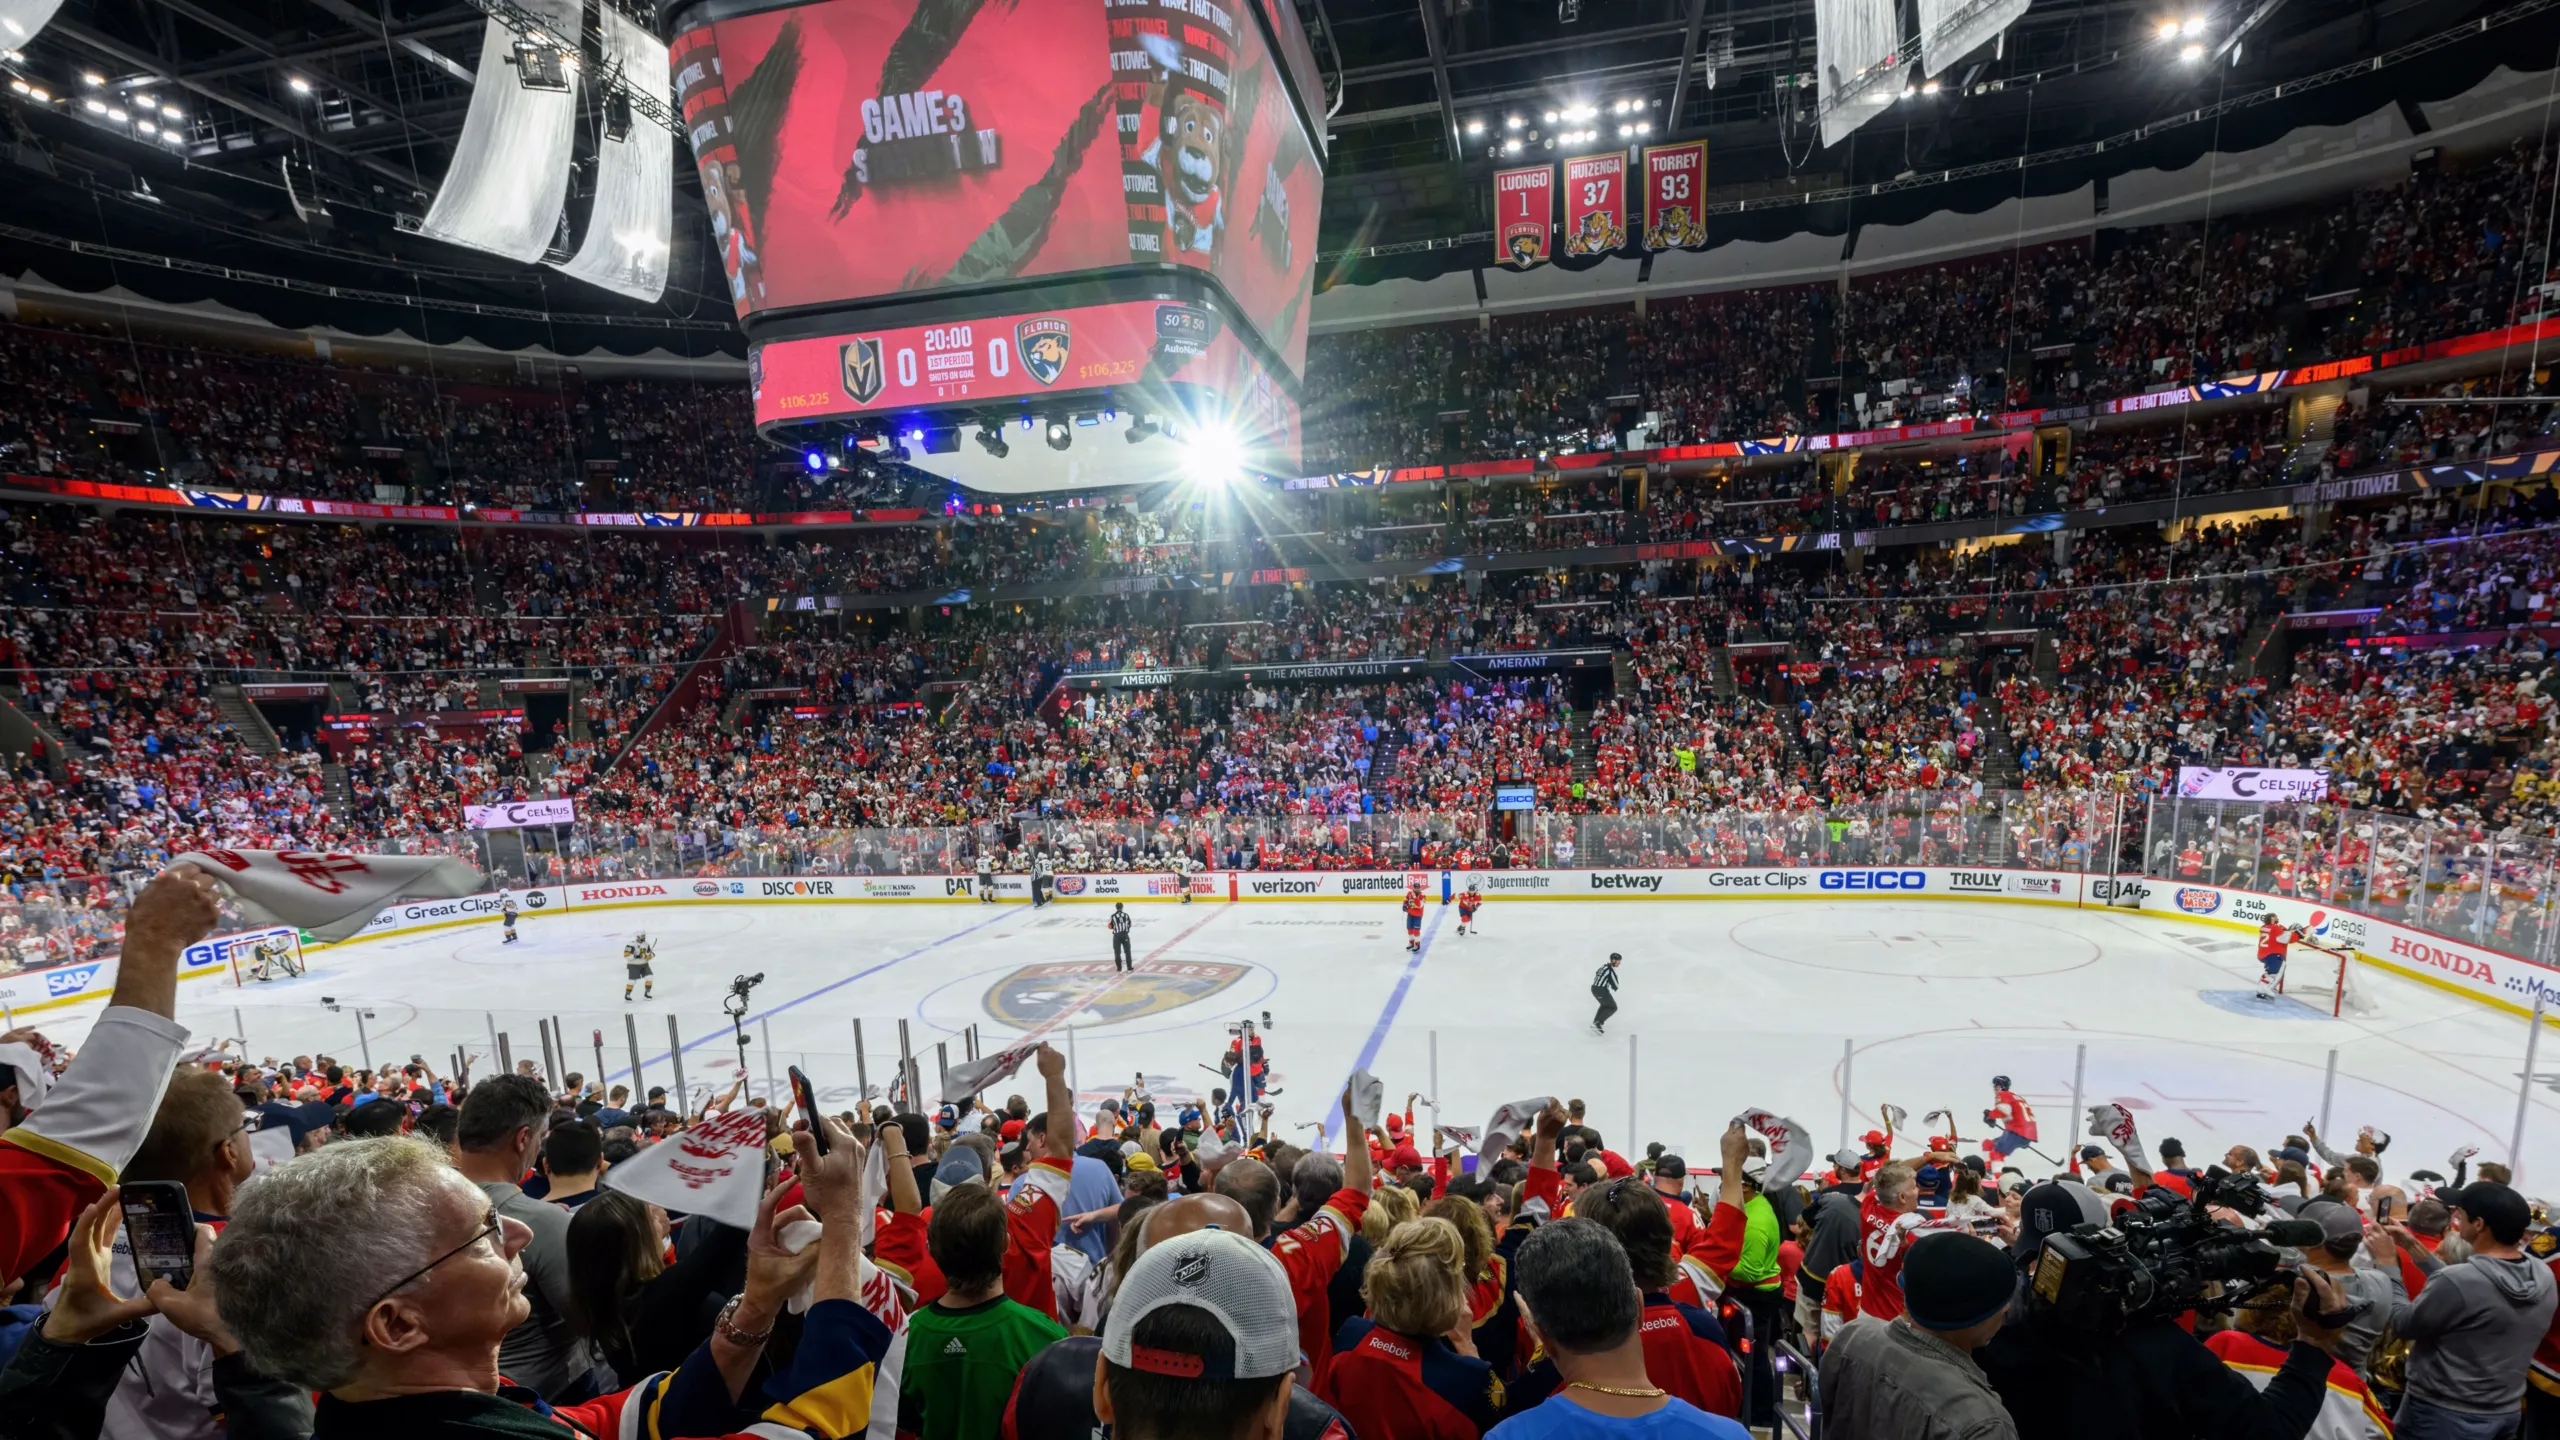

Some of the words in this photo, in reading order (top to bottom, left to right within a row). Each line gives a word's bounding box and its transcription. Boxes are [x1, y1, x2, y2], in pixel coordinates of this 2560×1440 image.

[1212, 3, 1233, 37] TOWEL
[1120, 51, 1152, 70] TOWEL
[1189, 58, 1208, 82] THAT
[861, 90, 948, 143] GAME
[947, 94, 965, 131] 3
[1571, 159, 1620, 179] HUIZENGA
[1652, 152, 1698, 172] TORREY
[1134, 175, 1158, 193] TOWEL
[1500, 172, 1548, 191] LUONGO
[1661, 174, 1689, 200] 93
[1583, 179, 1610, 206] 37
[1520, 192, 1529, 216] 1
[1023, 321, 1066, 336] FLORIDA
[1164, 315, 1180, 327] 50
[1193, 317, 1205, 331] 50
[924, 326, 973, 351] 20:00
[988, 337, 1009, 377] 0
[1164, 343, 1207, 358] AutoNation
[897, 348, 917, 387] 0
[929, 358, 942, 368] 1ST
[944, 355, 971, 367] PERIOD
[1080, 360, 1135, 379] $106,225
[2313, 360, 2338, 381] THAT
[2340, 355, 2372, 377] TOWEL
[928, 372, 950, 382] SHOTS
[950, 371, 959, 380] ON
[959, 369, 975, 379] GOAL
[780, 392, 829, 409] $106,225
[2121, 398, 2139, 412] WAVE
[2139, 394, 2158, 410] THAT
[2158, 389, 2190, 407] TOWEL
[1308, 476, 1329, 489] TOWEL
[2320, 481, 2349, 499] THAT
[2351, 473, 2400, 497] TOWEL
[600, 513, 613, 525] THAT
[614, 513, 637, 526] TOWEL
[1262, 568, 1282, 584] THAT
[1267, 669, 1286, 679] THE
[1289, 667, 1345, 678] AMERANT
[1348, 664, 1388, 675] VAULT
[1488, 657, 1548, 669] AMERANT
[1121, 674, 1173, 686] AMERANT
[1498, 795, 1534, 803] GEICO
[946, 878, 973, 896] CAT
[1253, 878, 1316, 893] verizon
[1342, 874, 1404, 891] guaranteed
[1408, 876, 1427, 886] Rate
[1591, 873, 1663, 892] betway
[1709, 872, 1761, 887] Great
[1764, 872, 1807, 889] Clips
[1819, 871, 1926, 889] GEICO
[1950, 872, 2002, 887] TRULY
[2022, 878, 2049, 886] TRULY
[582, 885, 667, 900] HONDA
[693, 885, 720, 893] Glidden
[763, 881, 834, 896] DISCOVER
[1095, 886, 1119, 894] above
[2181, 888, 2216, 900] Jersey
[405, 904, 457, 919] Great
[460, 898, 501, 914] Clips
[526, 895, 546, 905] TNT
[2236, 899, 2242, 907] a
[2246, 899, 2267, 911] sub
[2232, 909, 2265, 922] above
[2332, 917, 2366, 937] pepsi
[2389, 935, 2496, 985] HONDA
[1040, 964, 1221, 977] PANHERS
[48, 970, 92, 992] SAP
[1179, 1262, 1205, 1279] NHL
[1369, 1337, 1411, 1360] Reebok
